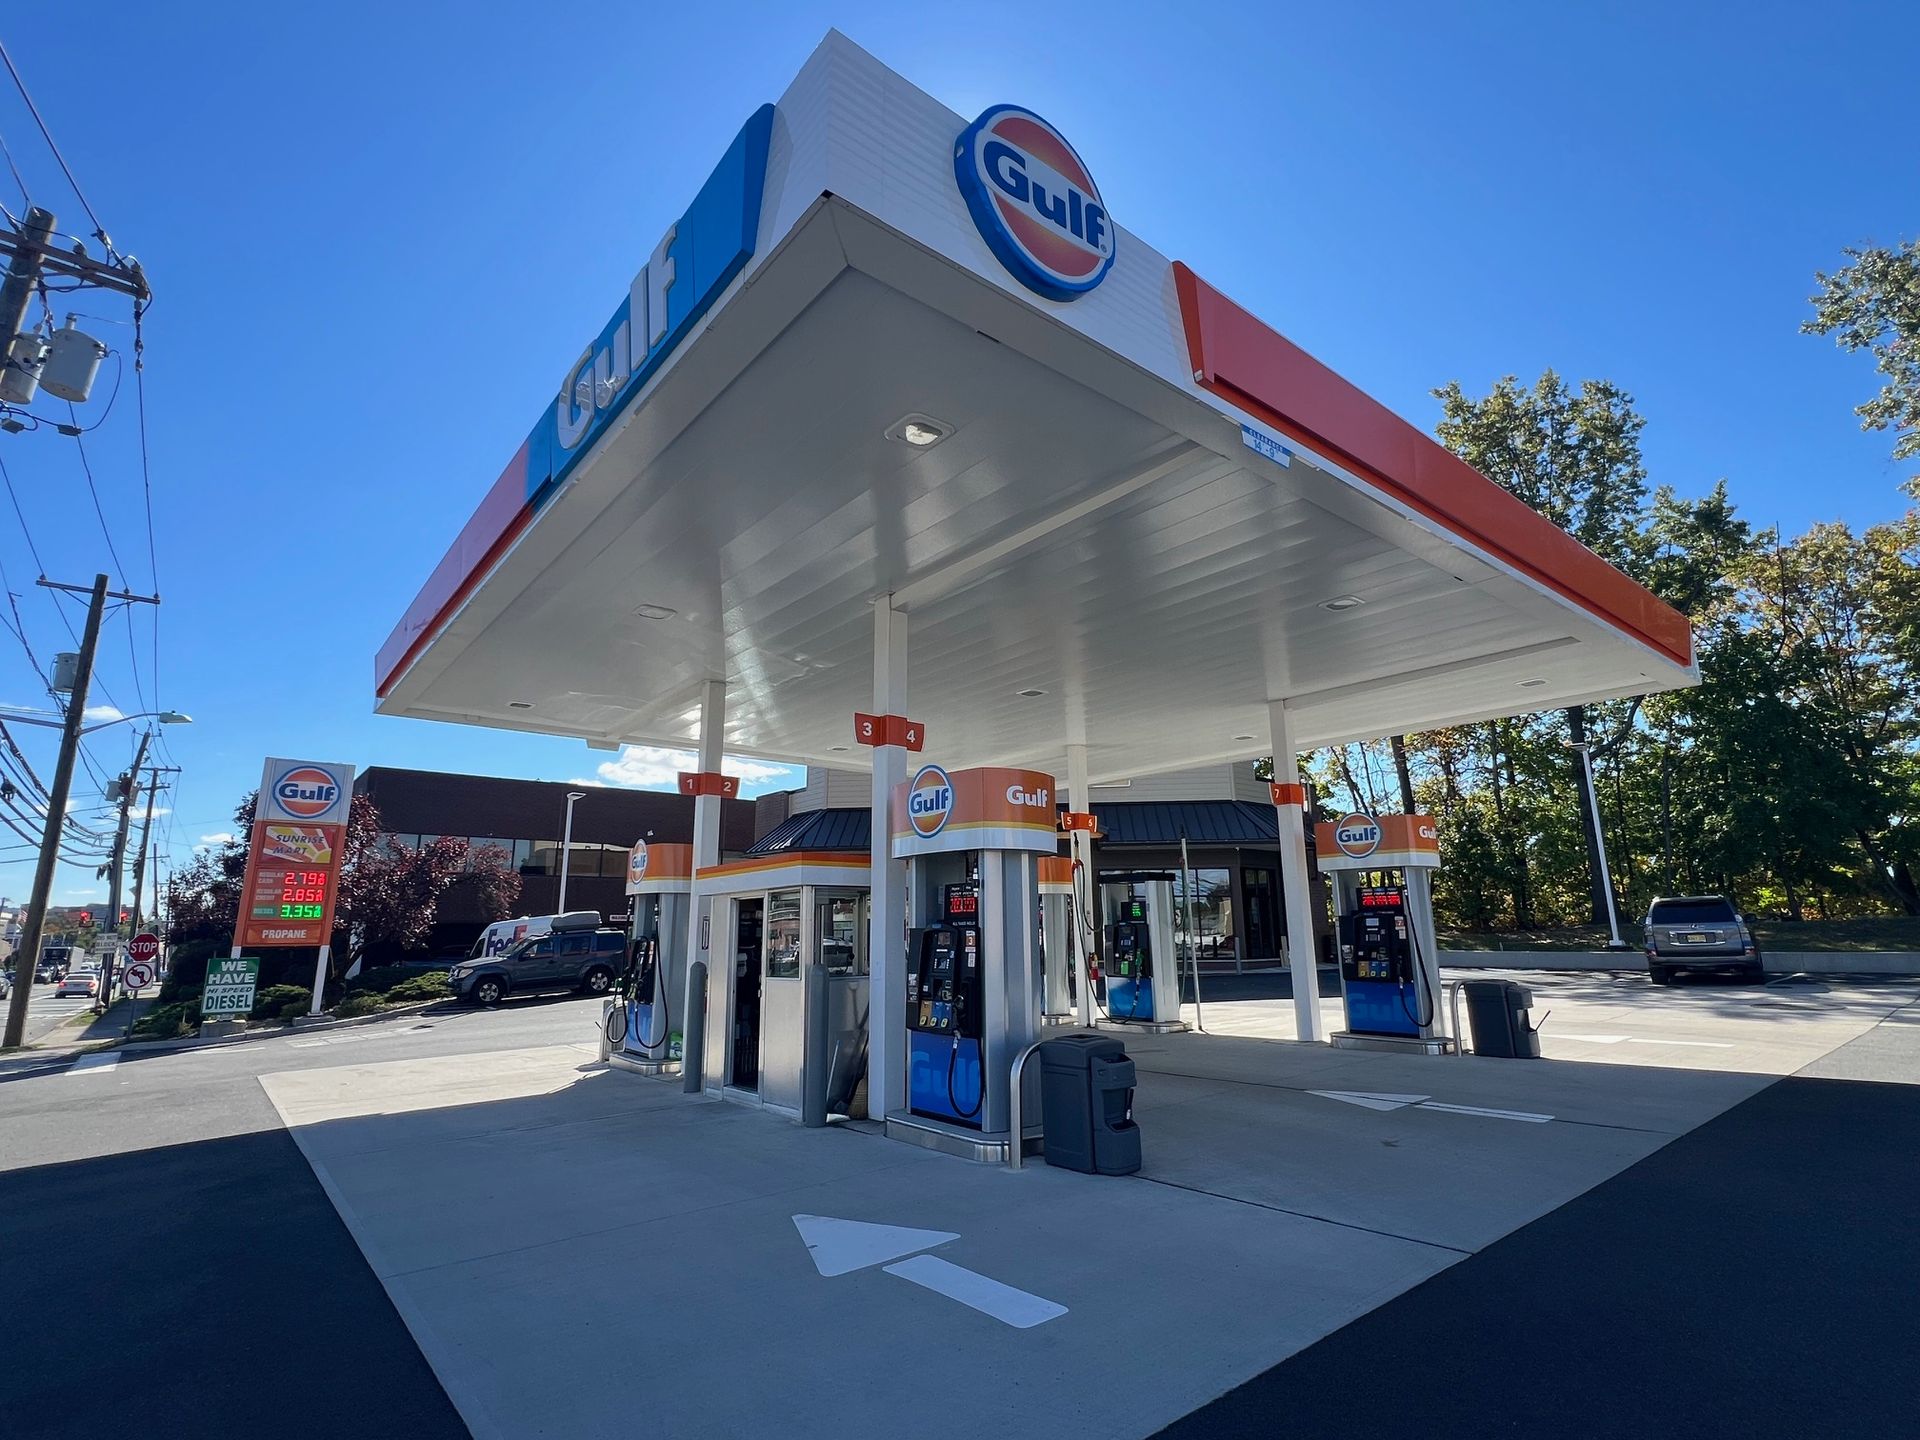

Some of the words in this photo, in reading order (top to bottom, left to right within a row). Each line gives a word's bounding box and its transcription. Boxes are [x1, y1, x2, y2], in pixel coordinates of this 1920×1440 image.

[984, 140, 1105, 250] Gulf
[557, 218, 681, 450] Gulf
[862, 721, 873, 737] 3
[906, 729, 916, 743] 4
[686, 778, 693, 790] 1
[723, 781, 732, 792] 2
[278, 782, 336, 801] Gulf
[1006, 785, 1048, 808] Gulf
[1274, 788, 1280, 799] 7
[910, 787, 949, 814] Gulf
[1066, 816, 1072, 825] 5
[275, 834, 325, 843] SUNRISE
[1338, 826, 1377, 843] Gulf
[1419, 825, 1438, 839] Gul
[273, 847, 308, 855] MART
[632, 854, 647, 869] Gulf
[262, 929, 307, 939] PROPANE
[130, 942, 158, 953] STOP
[221, 961, 248, 972] WE
[208, 973, 256, 985] HAVE
[204, 994, 252, 1010] DIESEL
